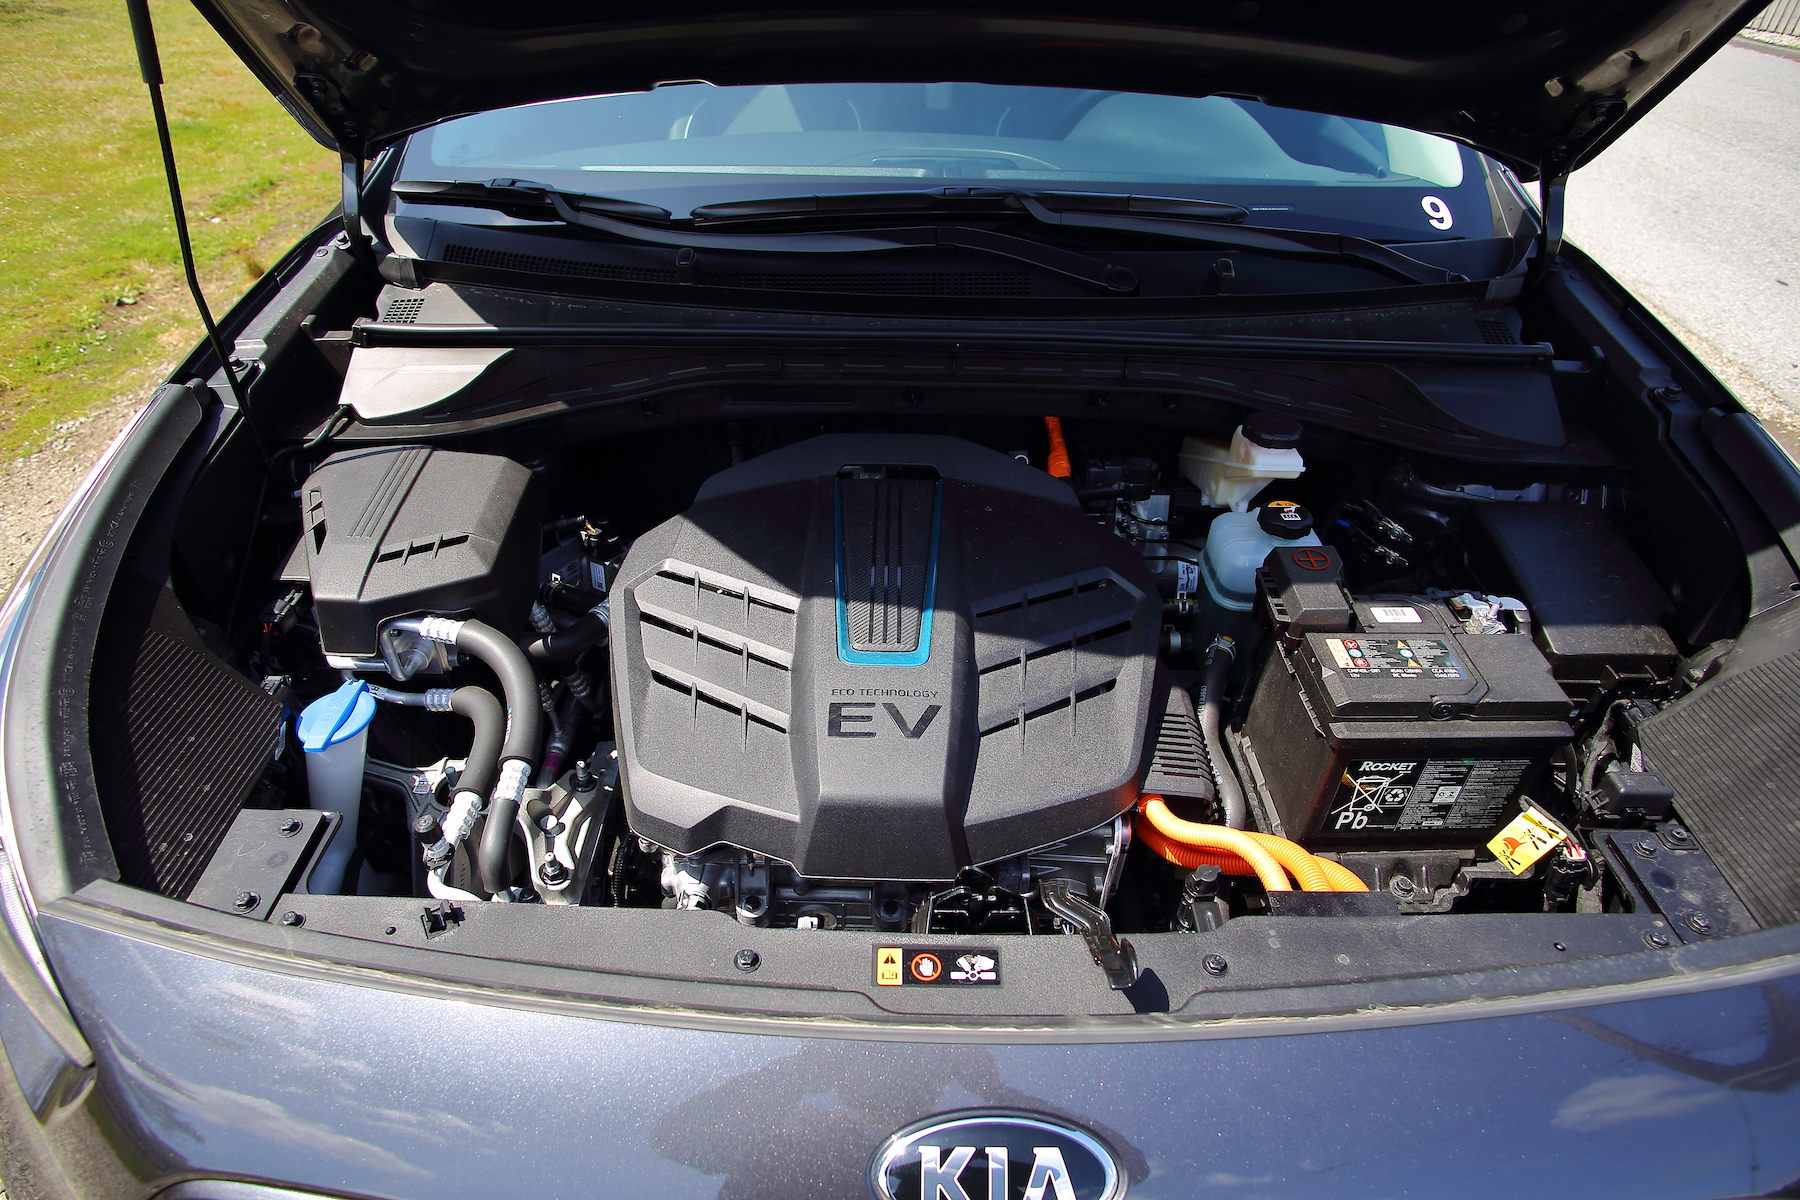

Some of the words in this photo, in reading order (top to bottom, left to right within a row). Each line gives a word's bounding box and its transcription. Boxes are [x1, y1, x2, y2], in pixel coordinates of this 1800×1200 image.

[1421, 195, 1453, 230] 9
[832, 688, 855, 696] ECO
[858, 688, 938, 698] TECHNOLOGY
[828, 702, 942, 739] EV
[1335, 811, 1368, 829] Pb
[918, 1146, 1077, 1200] KIA
